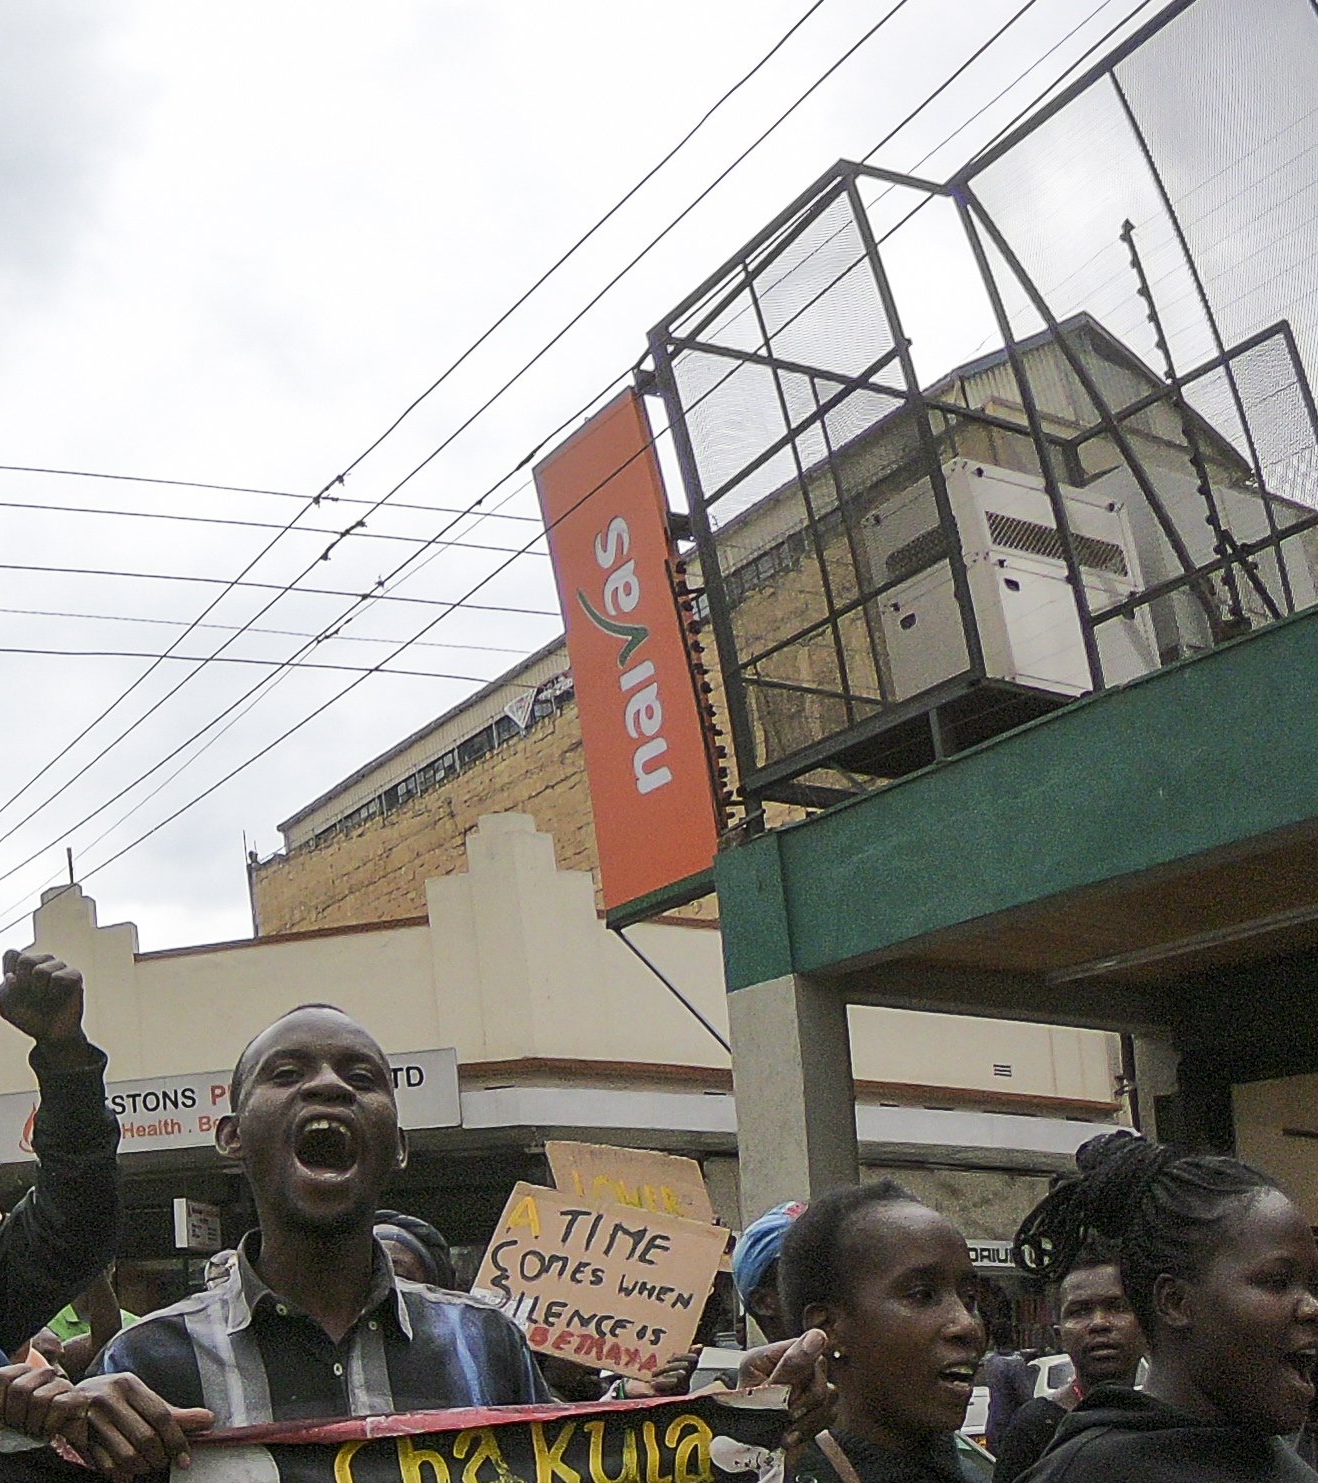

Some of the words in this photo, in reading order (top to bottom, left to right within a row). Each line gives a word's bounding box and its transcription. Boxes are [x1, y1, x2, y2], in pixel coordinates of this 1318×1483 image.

[577, 516, 672, 795] naivas
[506, 1195, 541, 1240] A
[559, 1208, 672, 1266] TIME
[490, 1239, 605, 1287] COMES
[617, 1273, 695, 1310] WHEN
[490, 1271, 635, 1340] SILENCE
[635, 1324, 668, 1347] IS
